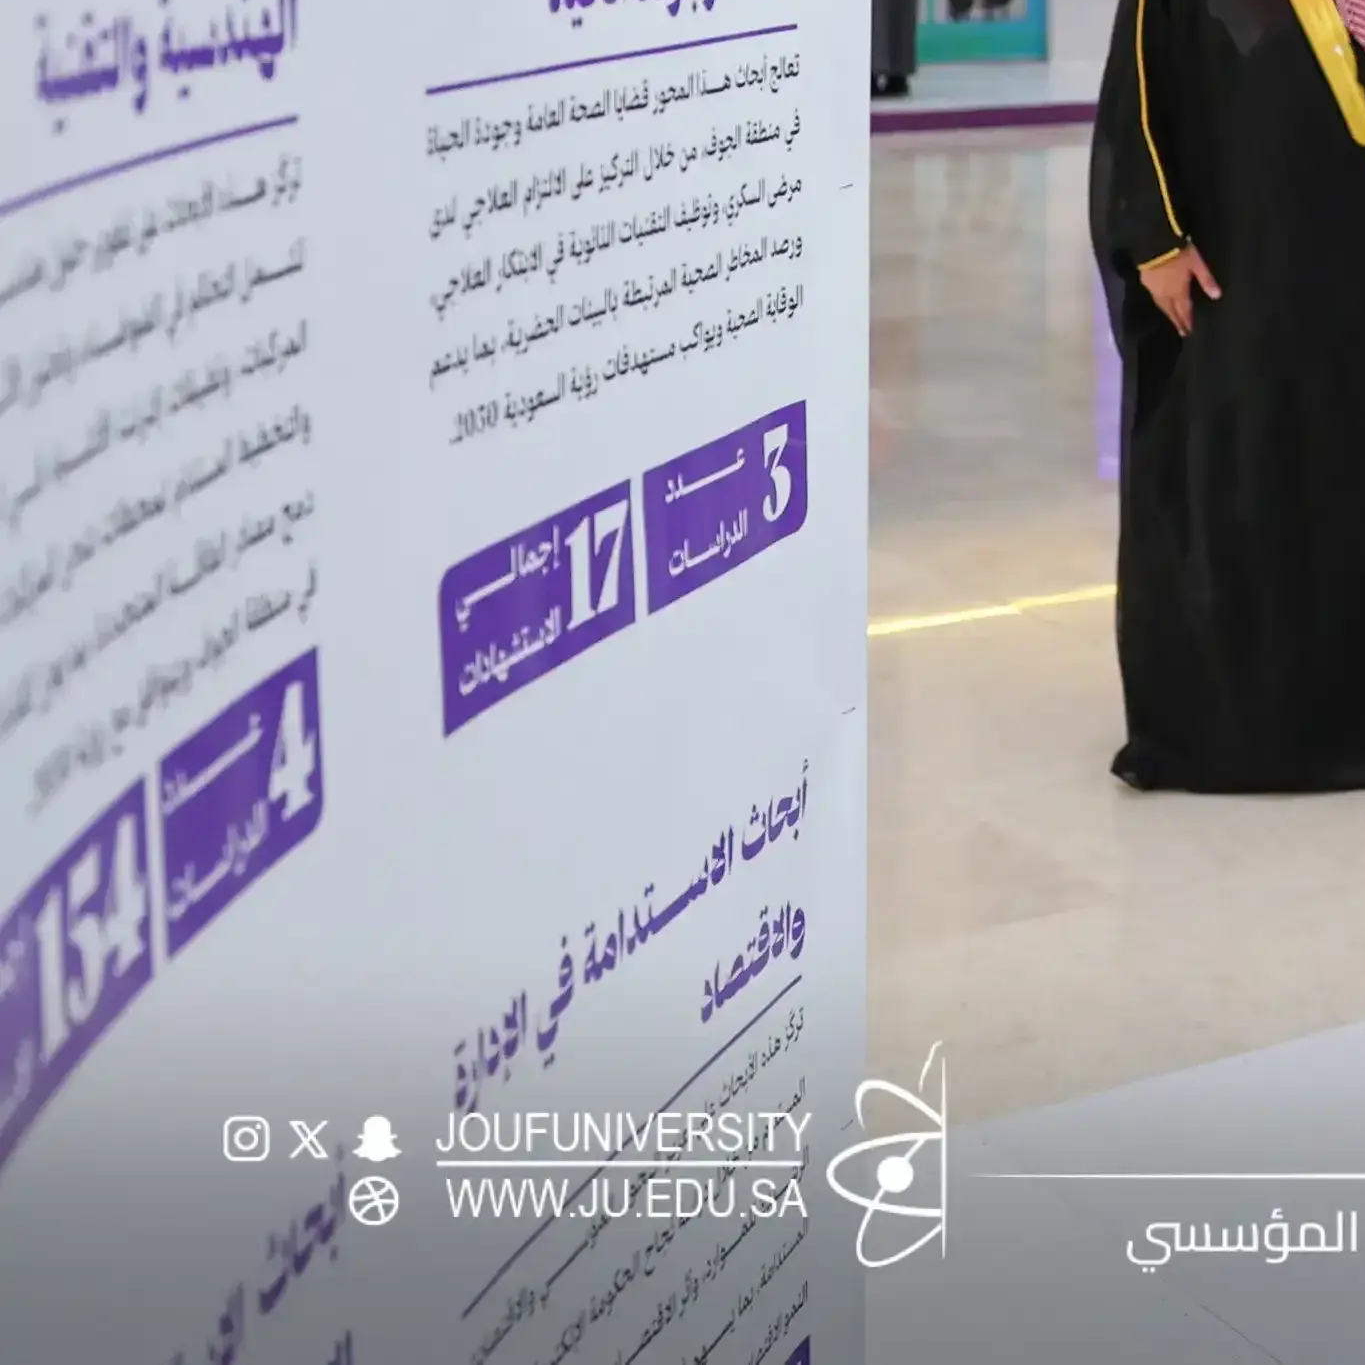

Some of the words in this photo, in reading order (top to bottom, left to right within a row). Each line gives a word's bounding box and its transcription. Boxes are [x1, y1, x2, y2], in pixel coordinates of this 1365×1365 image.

[735, 53, 768, 92] أبحاث
[663, 446, 747, 504] عدد
[762, 423, 793, 523] 3
[454, 524, 562, 634] إجمالي
[564, 499, 630, 632] 17
[668, 507, 750, 578] الدراسات
[458, 605, 563, 697] الاستشهادات
[268, 679, 316, 822] 4
[740, 757, 809, 862] أبحاث
[35, 812, 146, 1066] 154
[582, 824, 736, 986] الاستدامة
[534, 934, 576, 1071] في
[699, 898, 807, 1025] والاقتصاد
